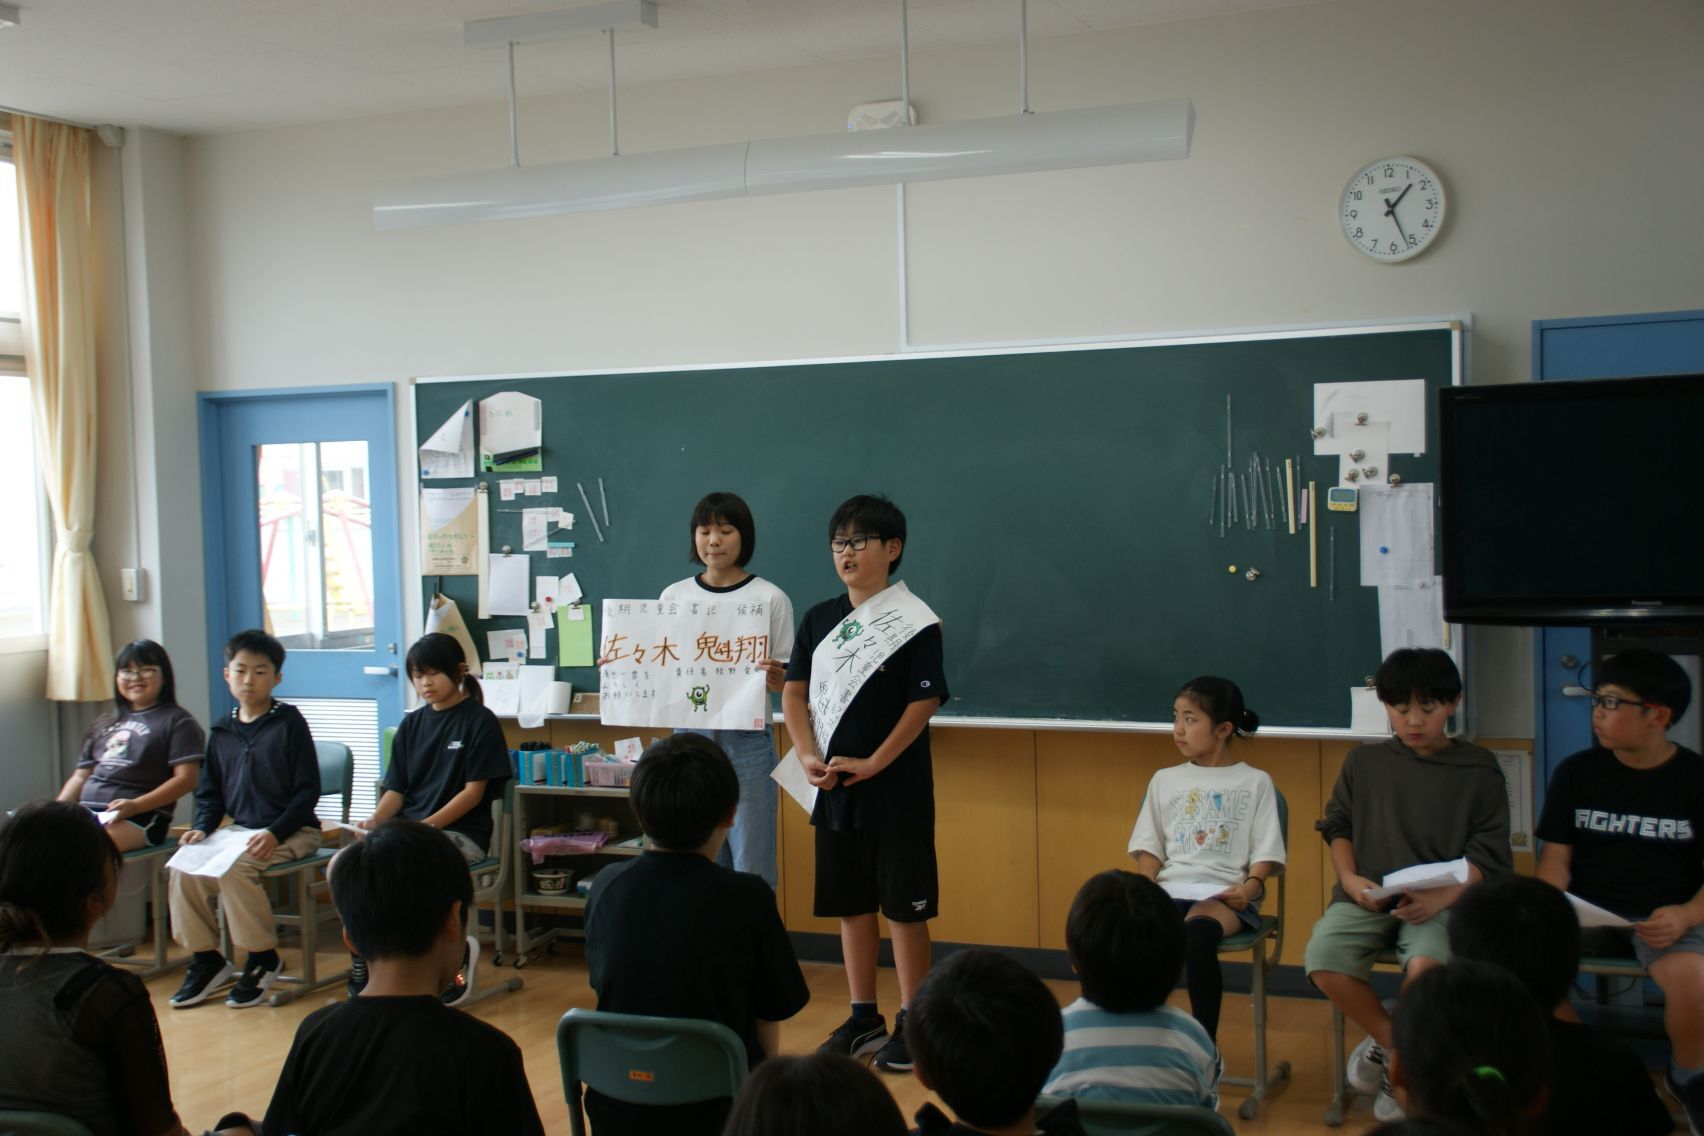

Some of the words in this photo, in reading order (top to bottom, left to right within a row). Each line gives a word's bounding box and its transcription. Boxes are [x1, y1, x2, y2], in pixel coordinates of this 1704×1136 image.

[1384, 167, 1394, 178] 12
[1406, 169, 1410, 180] 1
[1367, 175, 1374, 185] 11
[1419, 180, 1427, 190] 2
[1353, 190, 1363, 201] 10
[1426, 199, 1434, 210] 3
[1349, 209, 1358, 220] 9
[1422, 219, 1429, 228] 4
[1355, 227, 1364, 238] 8
[1371, 239, 1378, 249] 7
[1408, 234, 1417, 245] 5
[1389, 242, 1398, 252] 6
[832, 609, 904, 674] 佐々木
[603, 633, 680, 666] 佐々木
